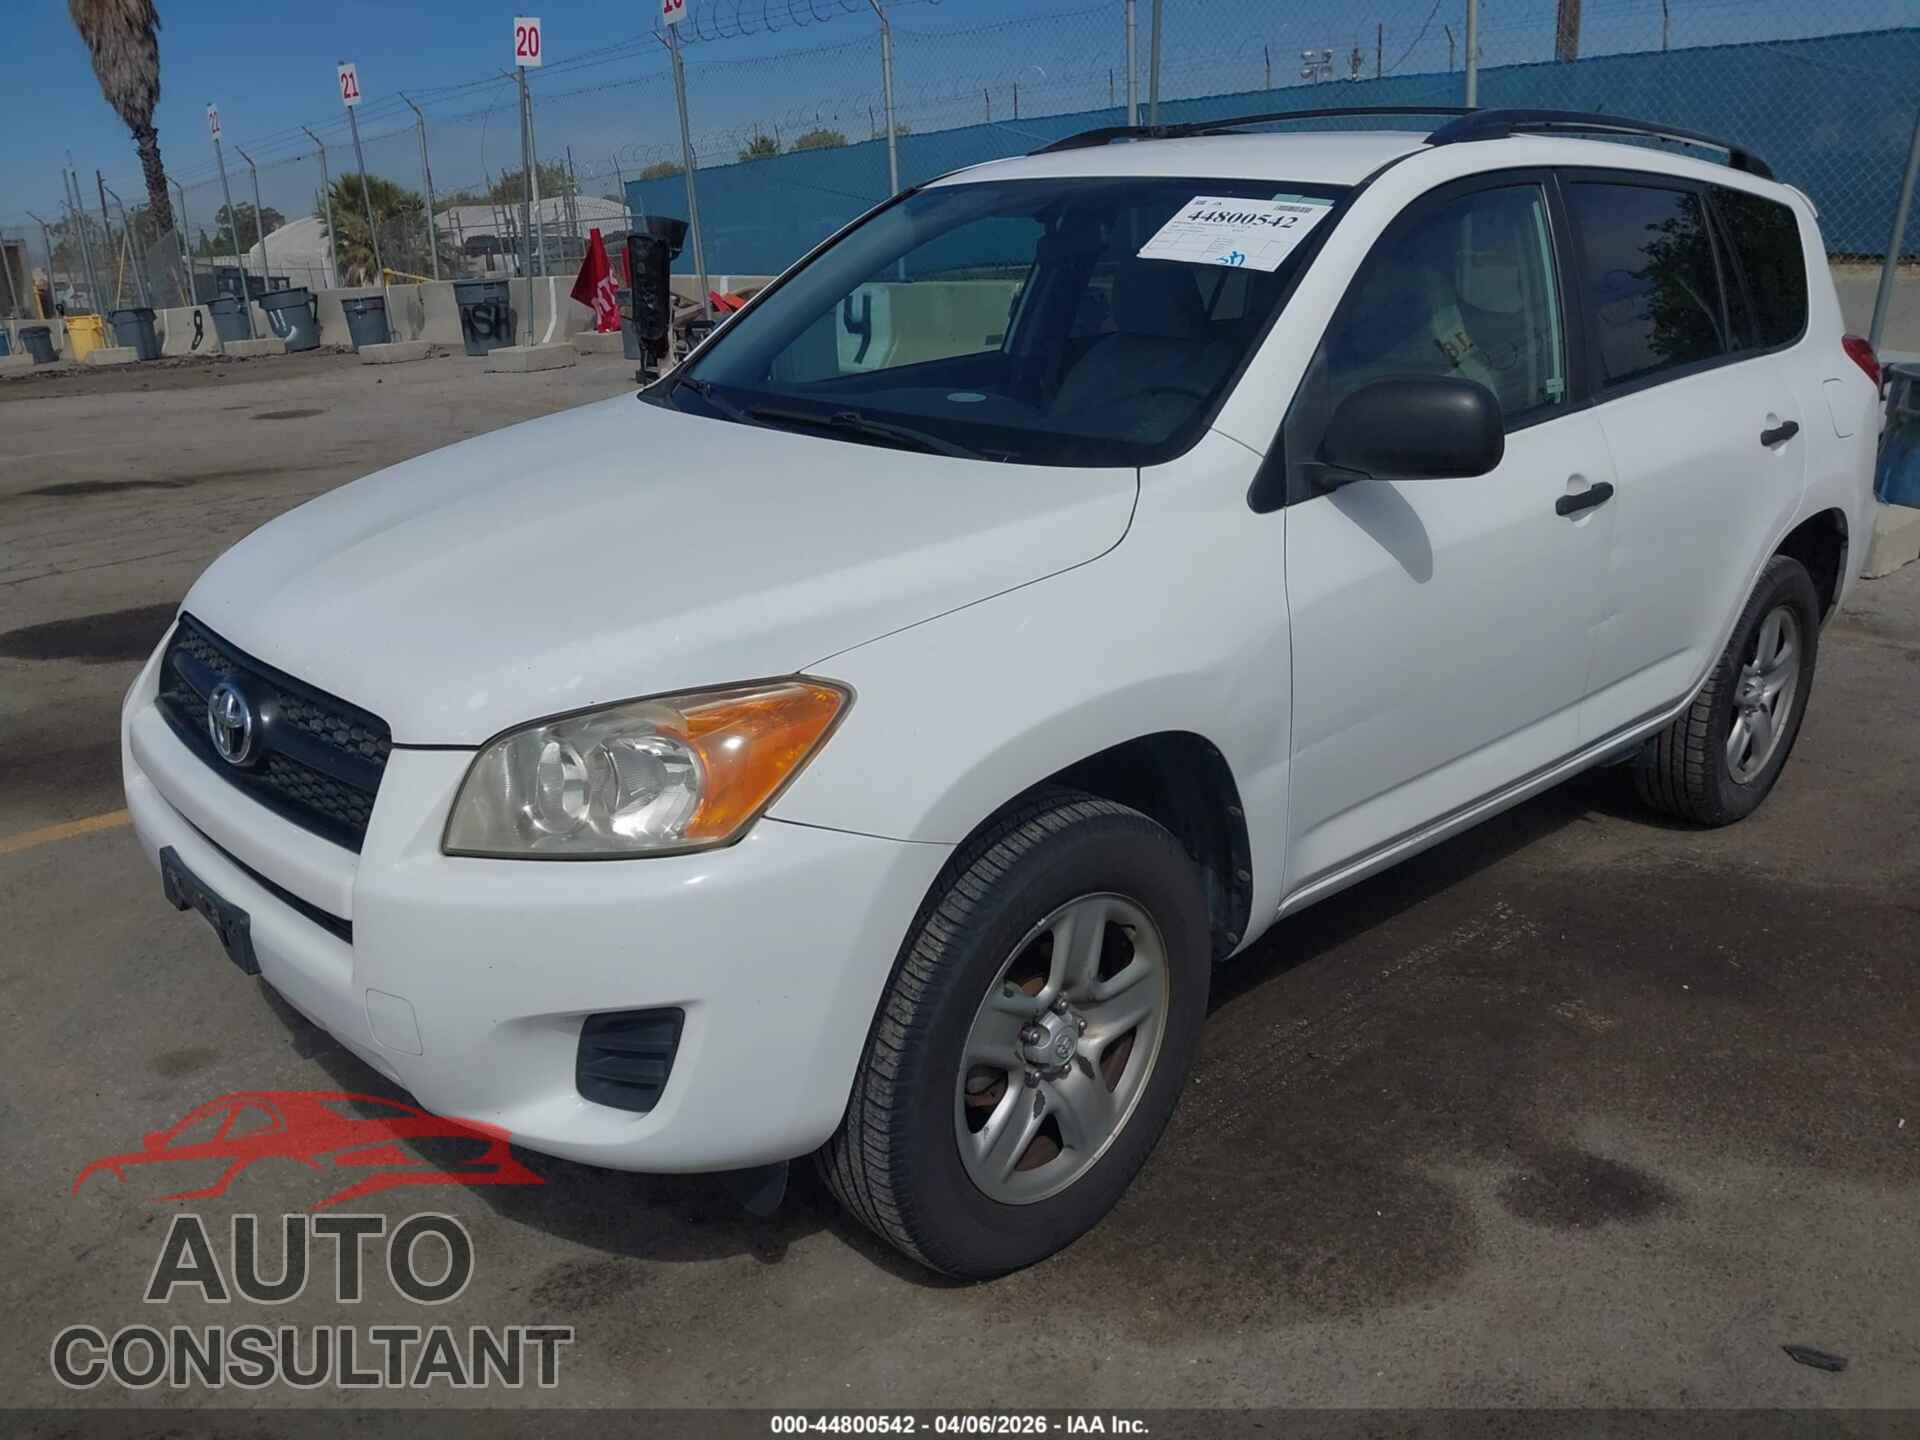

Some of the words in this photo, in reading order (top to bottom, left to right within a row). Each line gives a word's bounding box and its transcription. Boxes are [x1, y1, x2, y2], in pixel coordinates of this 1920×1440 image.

[516, 26, 539, 57] 20
[341, 72, 359, 99] 21
[1187, 209, 1298, 229] 44800542
